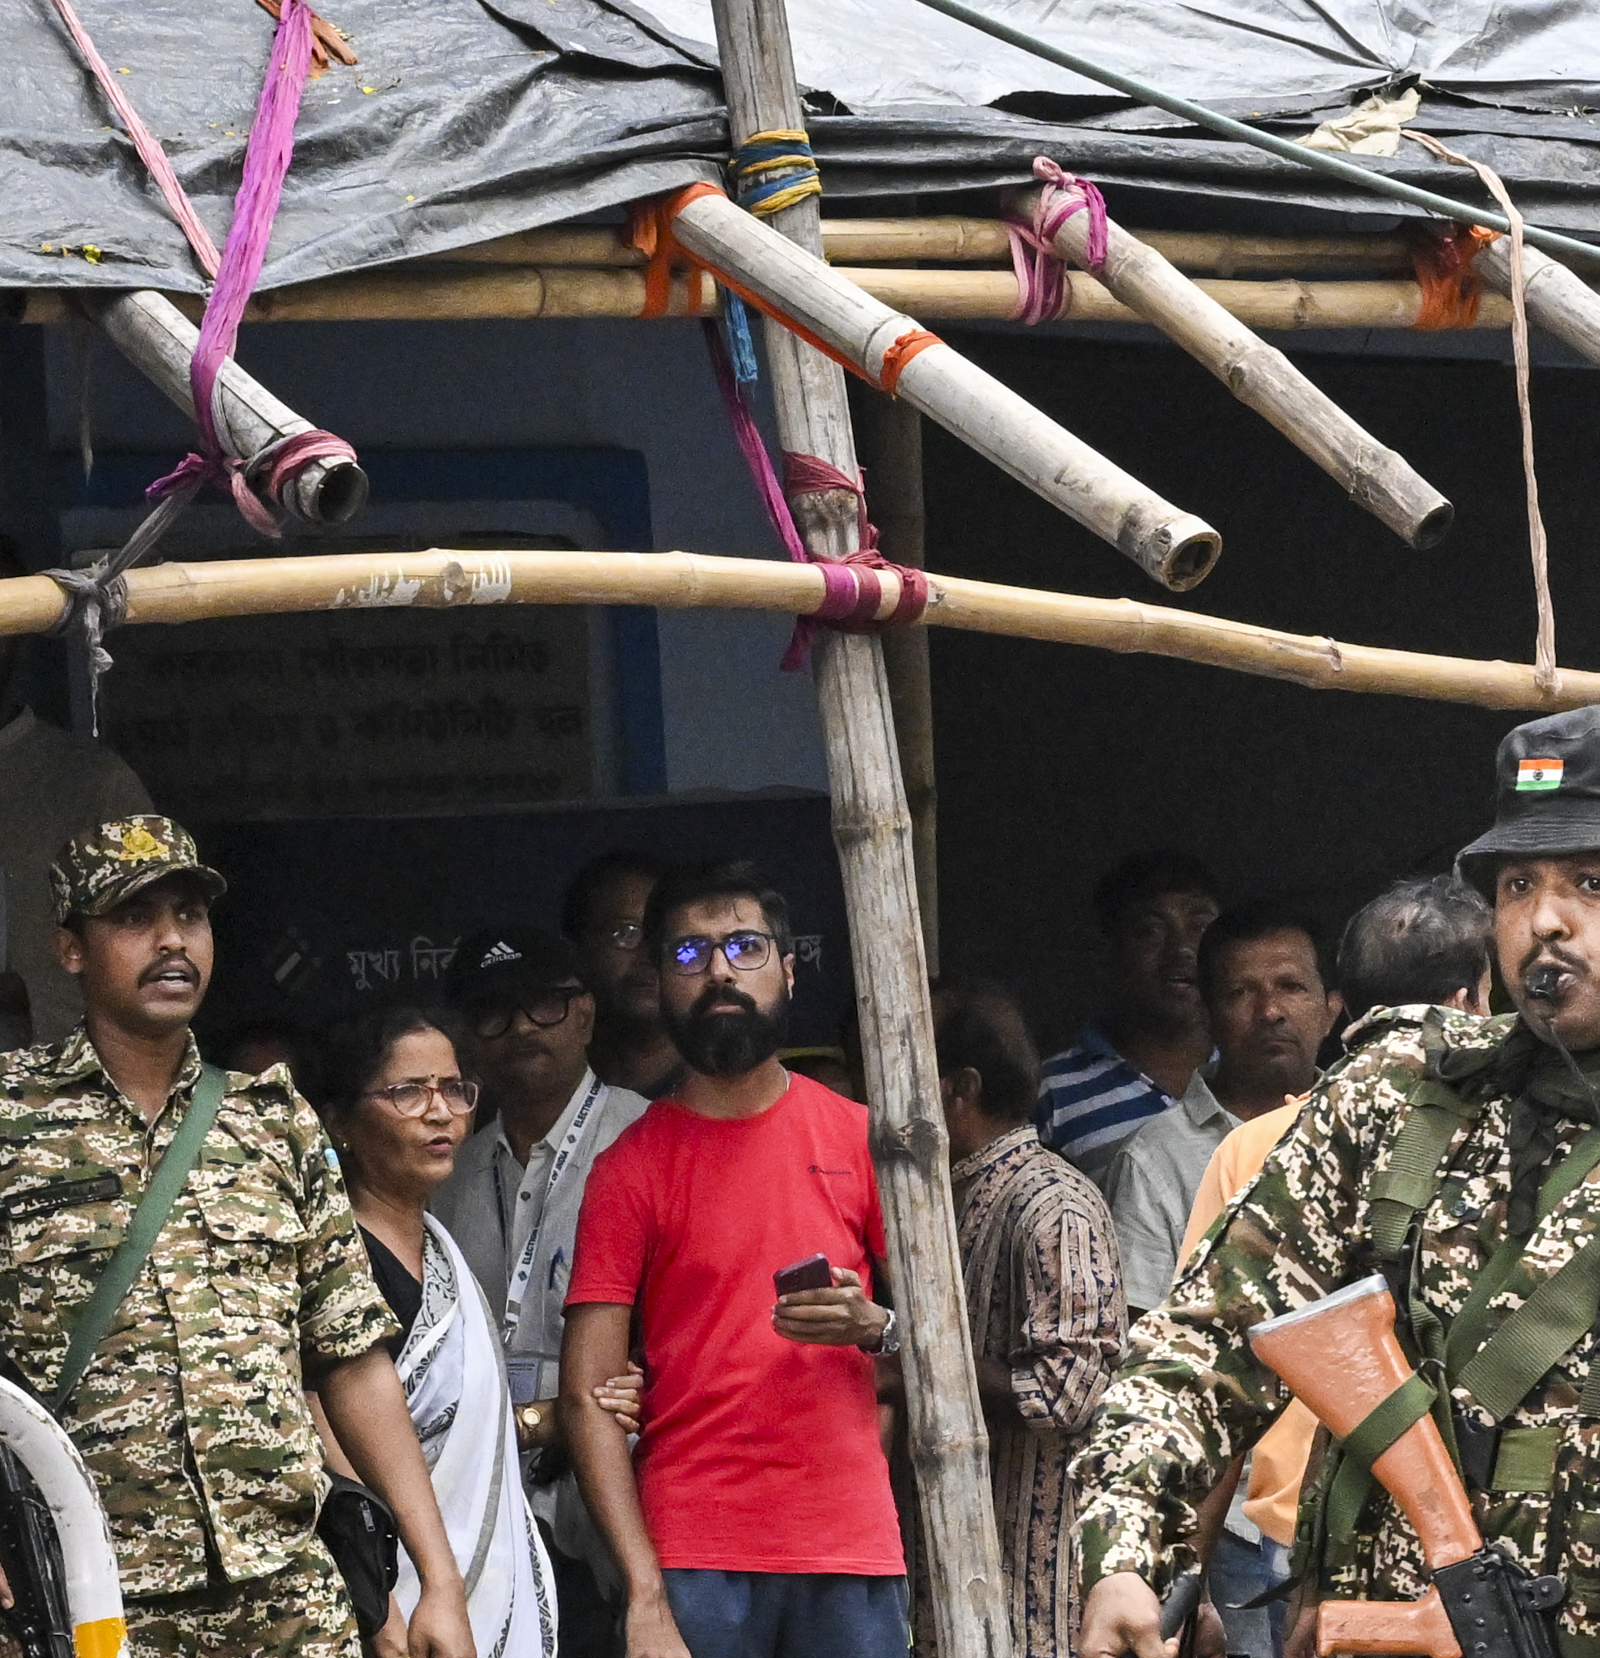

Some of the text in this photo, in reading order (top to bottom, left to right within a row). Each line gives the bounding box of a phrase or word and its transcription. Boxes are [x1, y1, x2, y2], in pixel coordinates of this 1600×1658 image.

[347, 949, 401, 991] মুখ্য
[573, 1092, 596, 1129] ELECTION
[557, 1149, 570, 1173] INDIA
